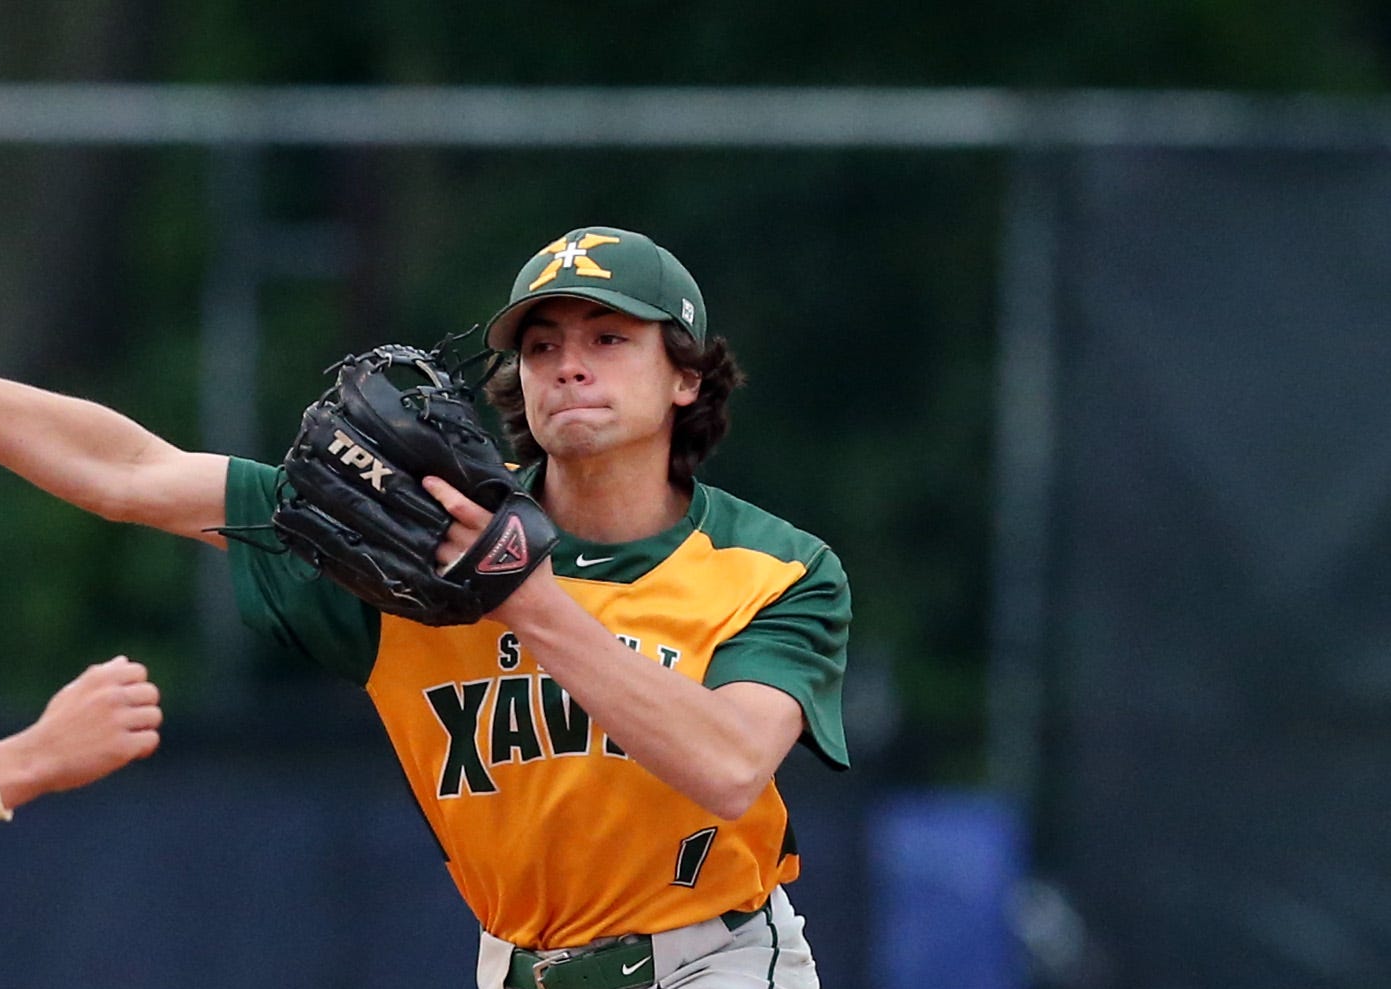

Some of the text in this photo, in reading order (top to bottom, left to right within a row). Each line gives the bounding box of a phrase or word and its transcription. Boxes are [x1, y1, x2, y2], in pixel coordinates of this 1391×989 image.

[327, 429, 393, 492] TPX
[422, 674, 630, 800] XAV
[669, 826, 718, 887] 1
